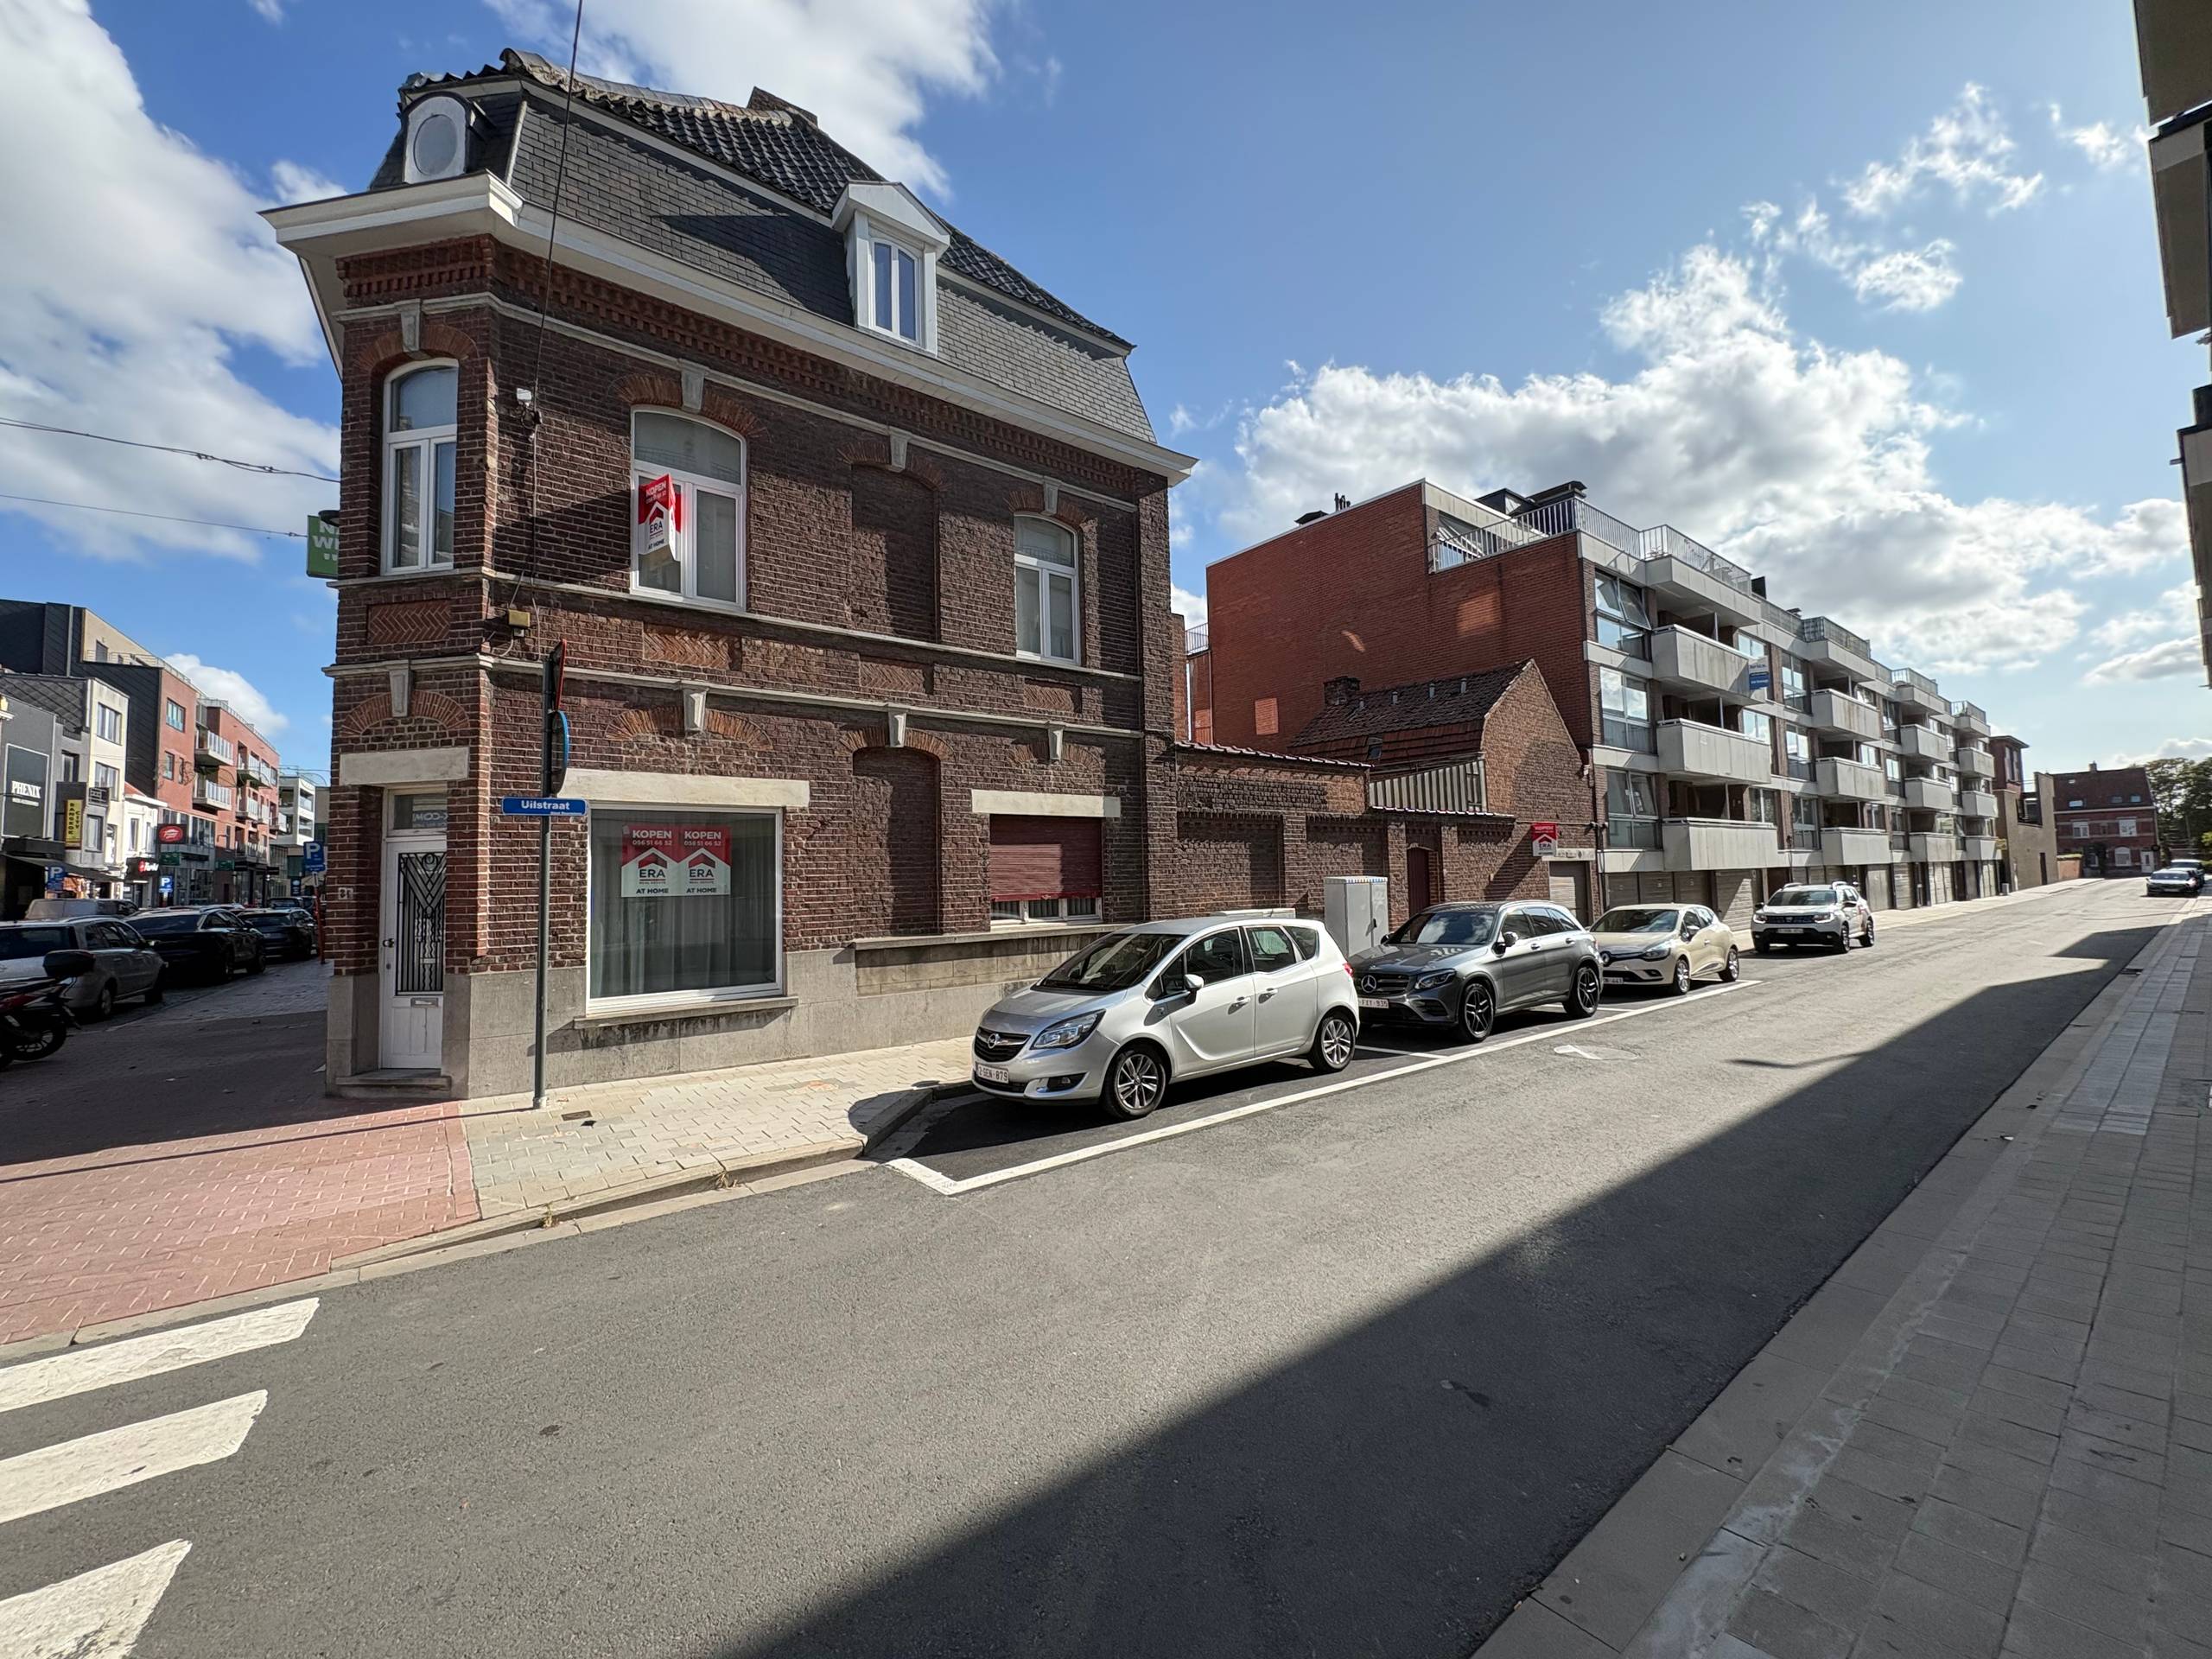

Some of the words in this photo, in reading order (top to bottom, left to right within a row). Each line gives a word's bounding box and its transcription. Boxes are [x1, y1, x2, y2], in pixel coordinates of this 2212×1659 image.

[649, 521, 663, 533] ERA
[11, 780, 41, 798] PHENIX
[521, 800, 569, 810] Uilstraat
[632, 830, 672, 839] KOPEN
[683, 831, 721, 840] KOPEN
[306, 842, 321, 859] P
[639, 868, 666, 879] ERA
[689, 868, 714, 878] ERA
